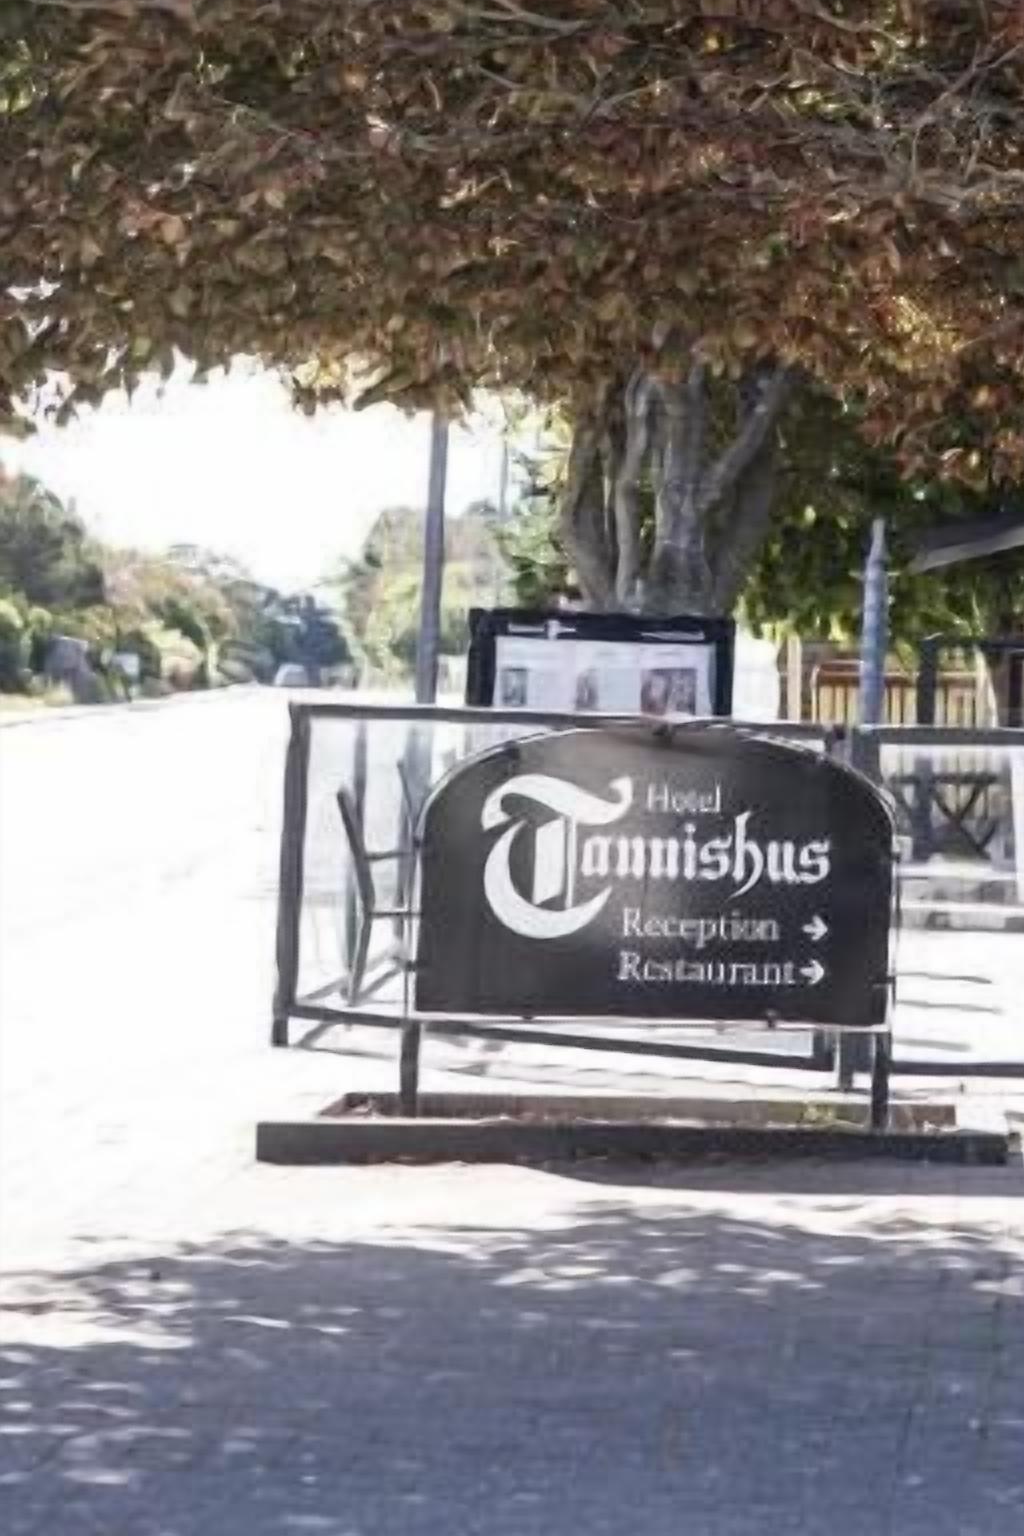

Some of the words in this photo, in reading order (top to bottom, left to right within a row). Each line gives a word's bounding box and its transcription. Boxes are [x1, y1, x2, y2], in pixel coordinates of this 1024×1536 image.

[647, 783, 721, 814] Hotel
[480, 773, 831, 939] Tannishus
[622, 908, 780, 948] Reception
[617, 952, 796, 986] Restaurant
